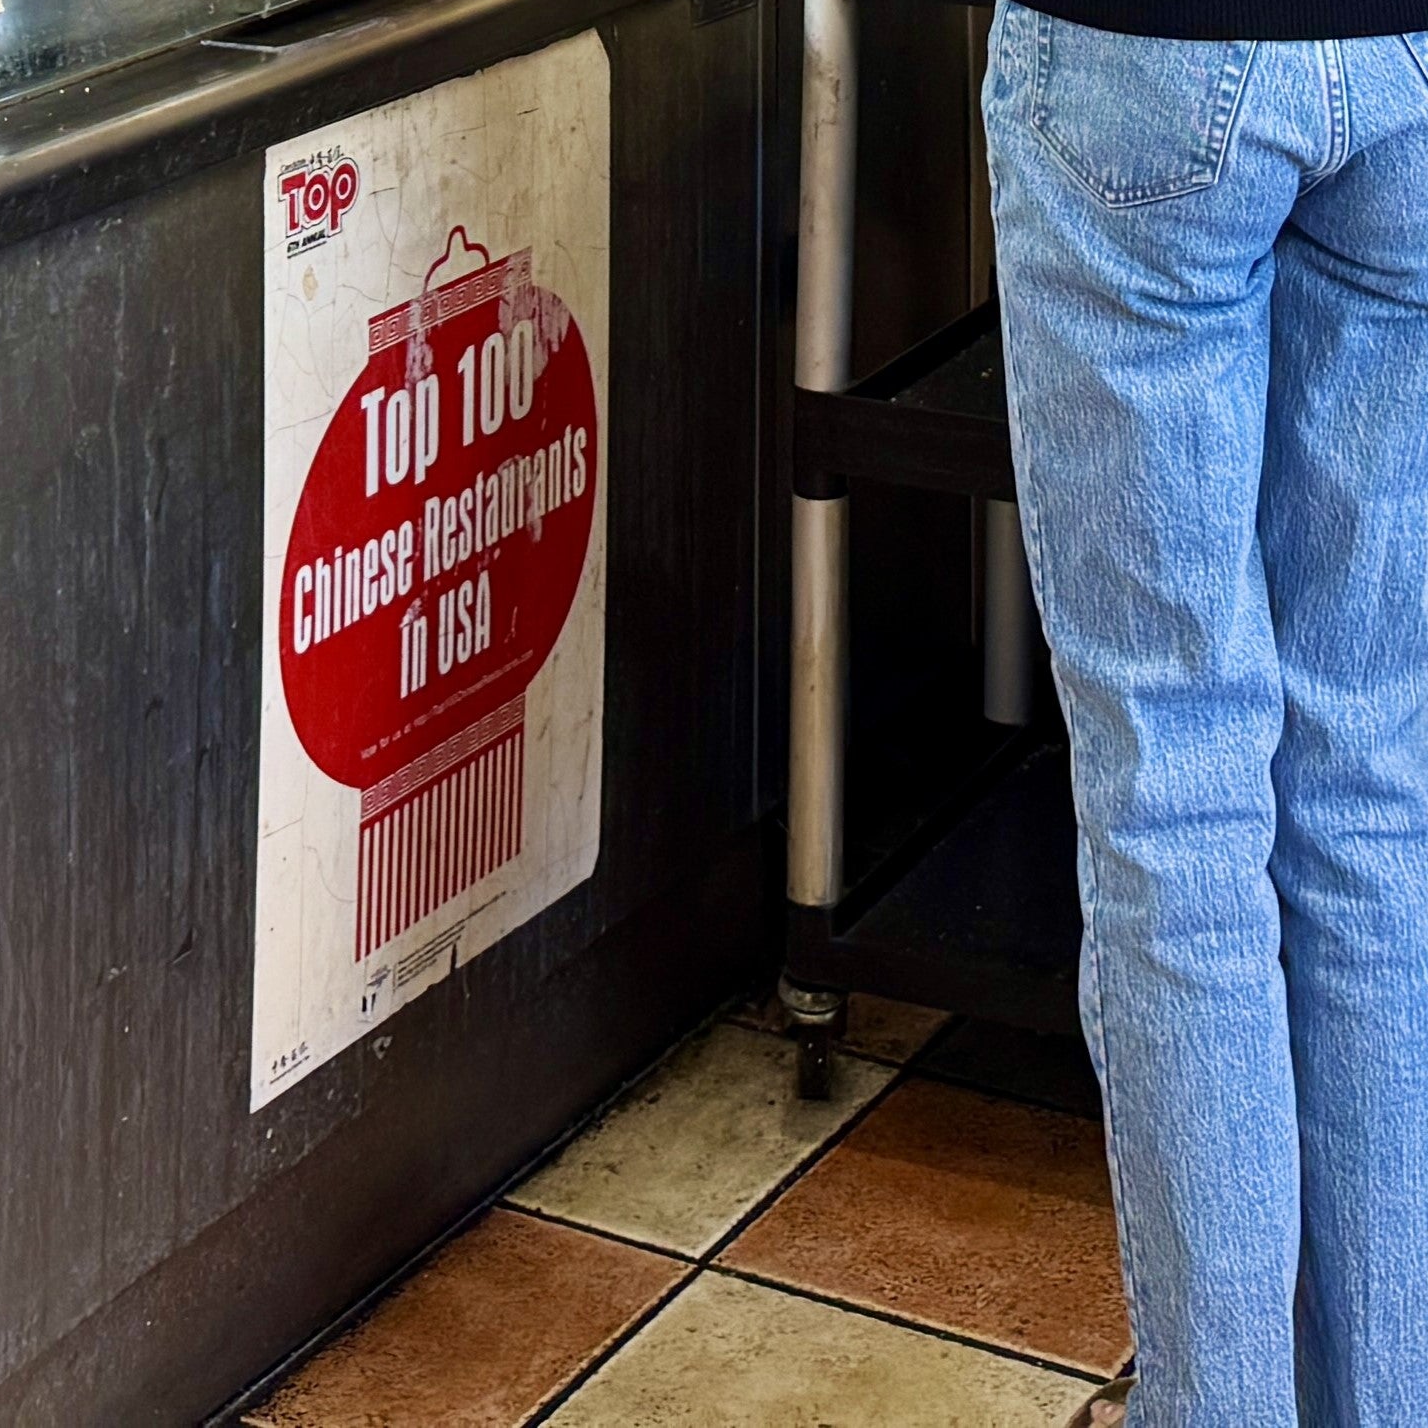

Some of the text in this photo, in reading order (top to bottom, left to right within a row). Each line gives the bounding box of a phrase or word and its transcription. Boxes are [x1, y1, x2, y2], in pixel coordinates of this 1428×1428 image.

[361, 320, 534, 498] Top 100
[294, 424, 587, 654] Chinese Restaurants
[438, 570, 490, 676] USA
